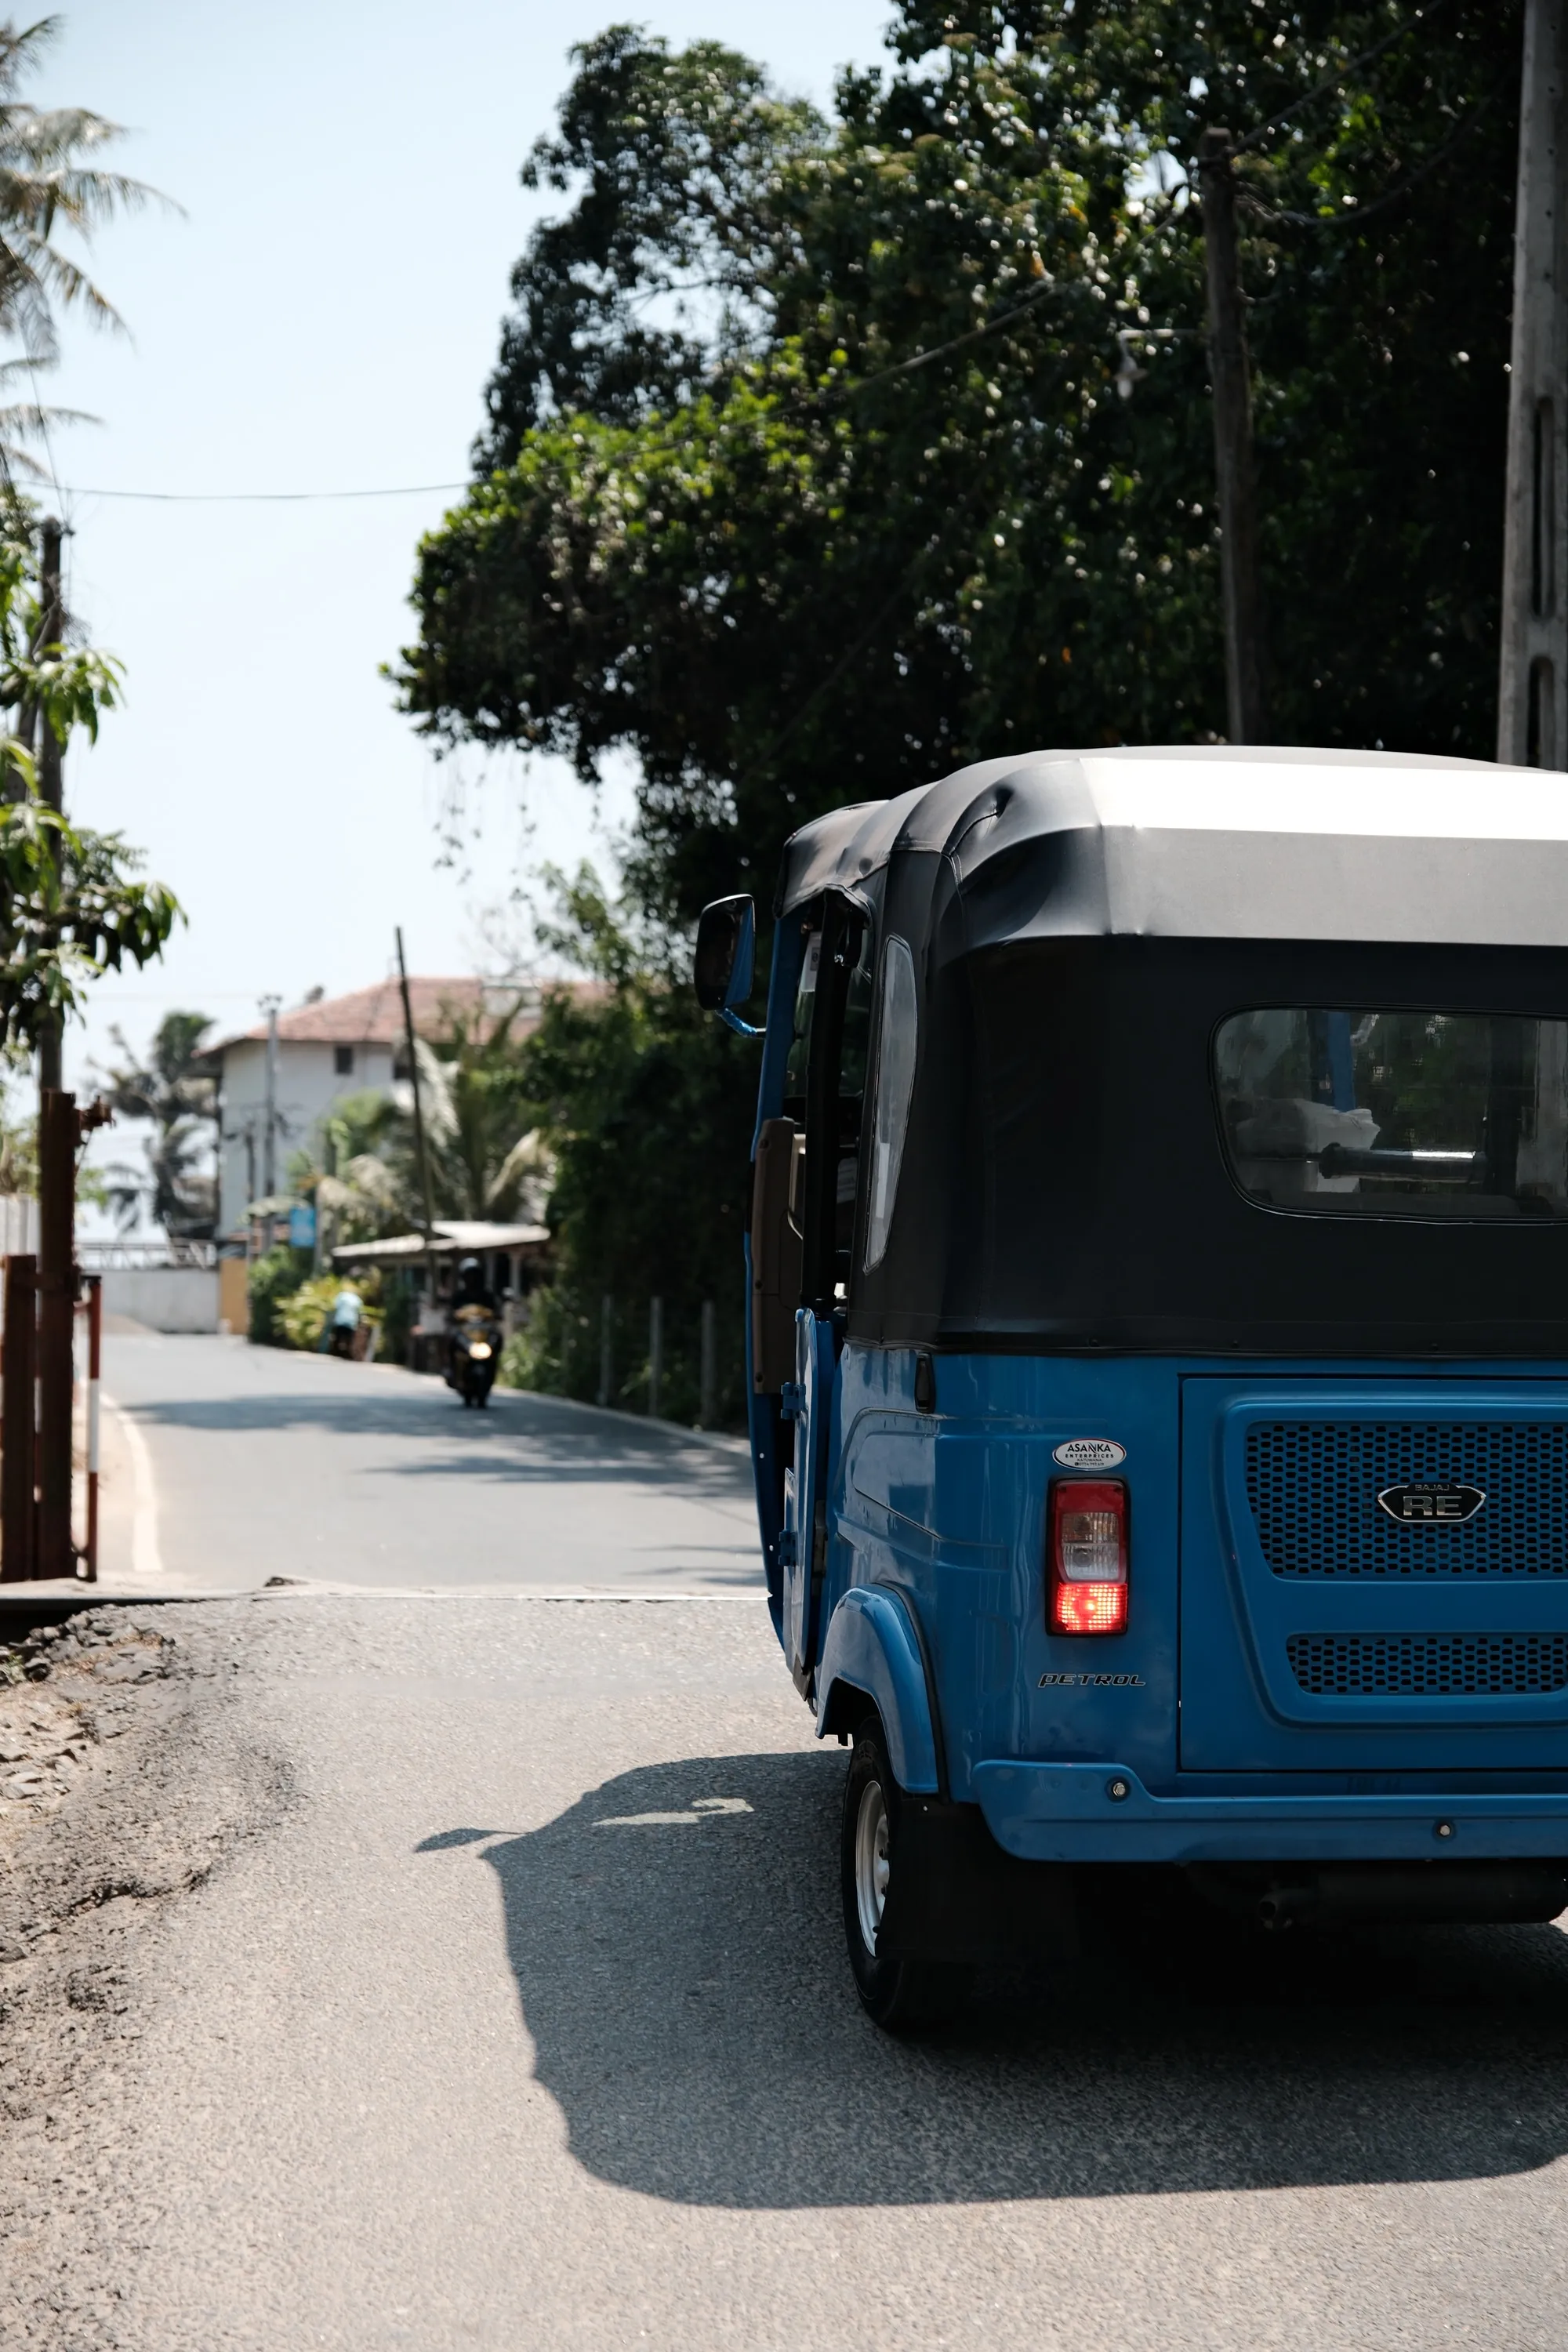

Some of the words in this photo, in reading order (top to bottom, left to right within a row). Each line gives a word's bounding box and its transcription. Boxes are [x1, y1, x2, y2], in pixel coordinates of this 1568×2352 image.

[1067, 1443, 1111, 1454] ASANKA
[1403, 1495, 1462, 1516] RE
[1038, 1673, 1146, 1688] PETROL
